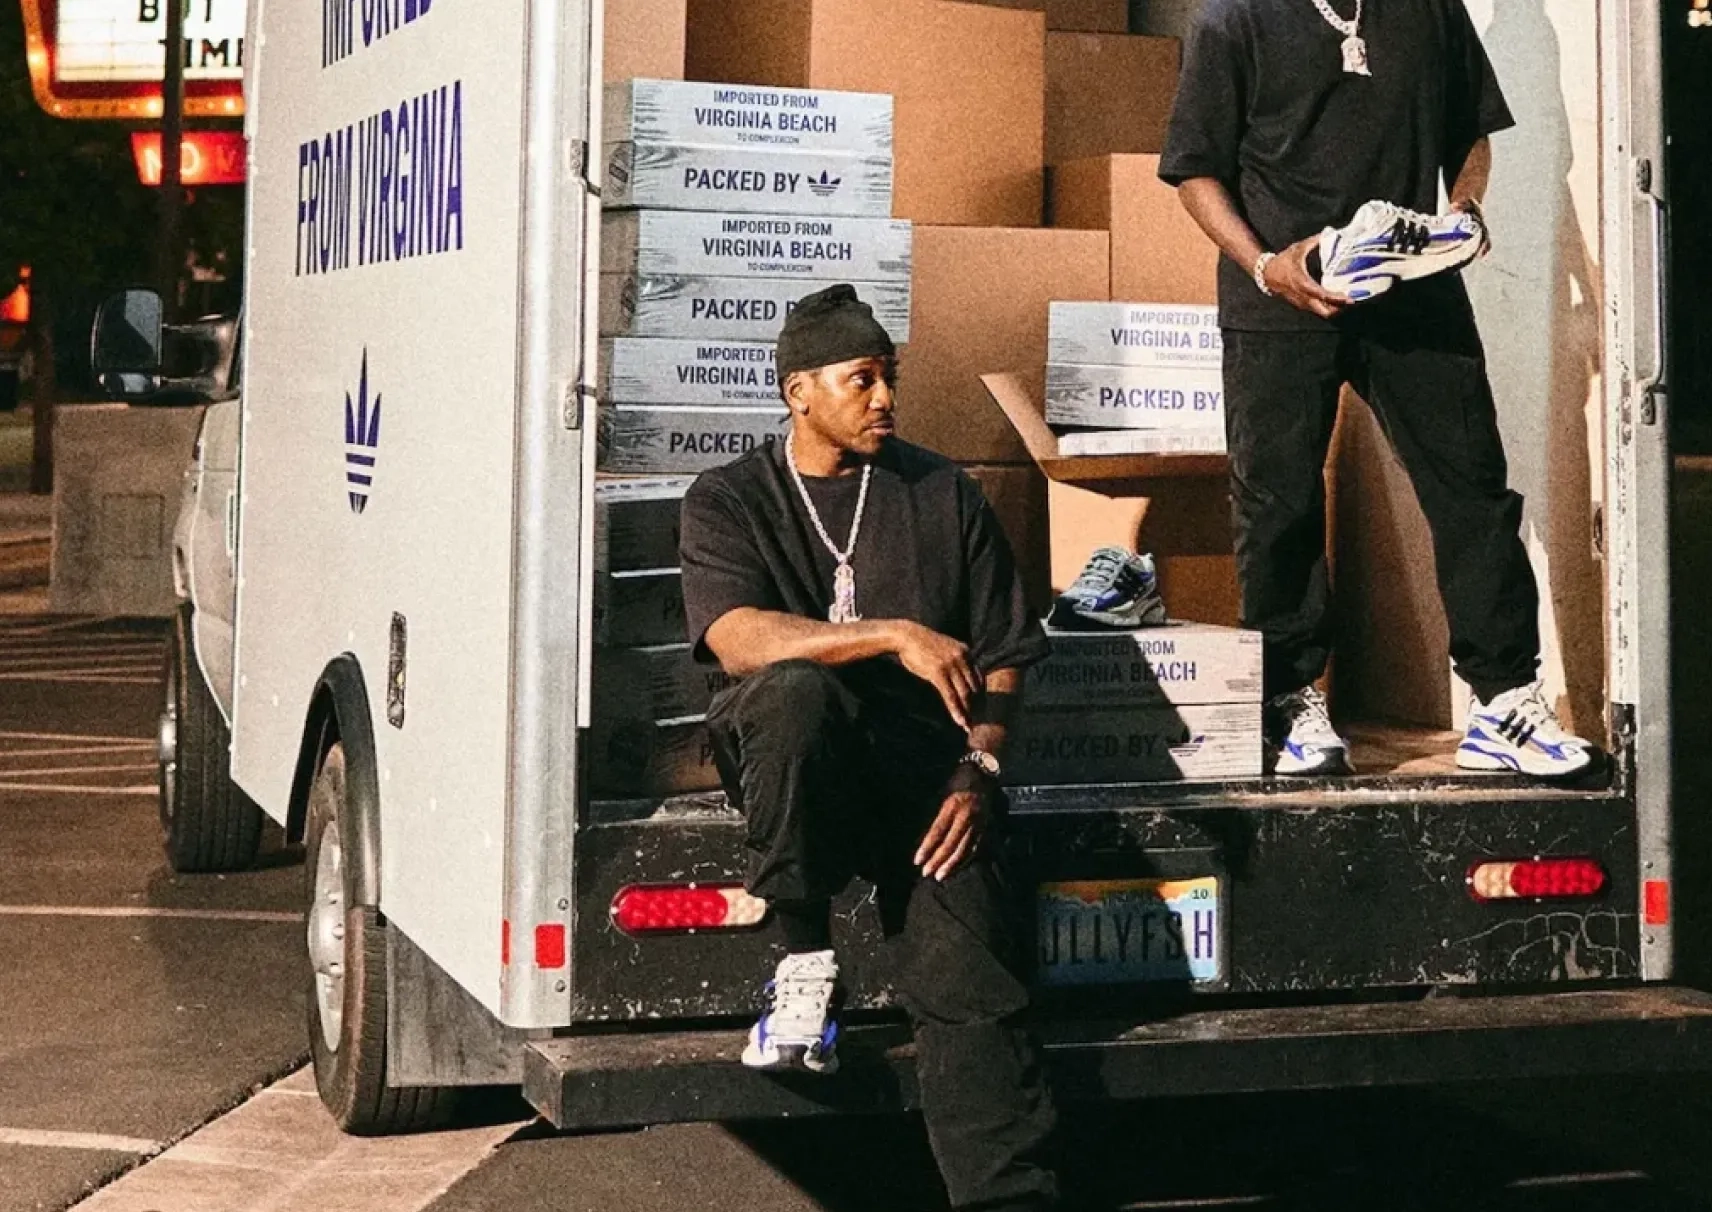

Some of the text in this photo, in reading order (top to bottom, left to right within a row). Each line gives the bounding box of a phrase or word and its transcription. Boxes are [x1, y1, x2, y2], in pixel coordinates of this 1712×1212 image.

[713, 89, 819, 109] IMPORTED FROM
[694, 107, 837, 134] VIRGINIA BEACH
[296, 79, 462, 277] FROM VIRGINIA
[684, 167, 800, 194] PACKED BY
[721, 219, 832, 236] IMPORTED FROM
[702, 237, 853, 261] VIRGINIA BEACH
[691, 298, 777, 321] PACKED
[1130, 310, 1200, 326] IMPORTED
[1110, 328, 1193, 349] VIRGINIA
[696, 347, 766, 362] IMPORTED
[676, 364, 759, 387] VIRGINIA
[1099, 386, 1221, 412] PACKED BY
[670, 432, 755, 454] PACKED
[1134, 640, 1176, 656] FROM
[1034, 661, 1197, 684] VIRGINIA BEACH
[1192, 889, 1208, 900] 10
[1043, 909, 1214, 965] JLLYFSH
